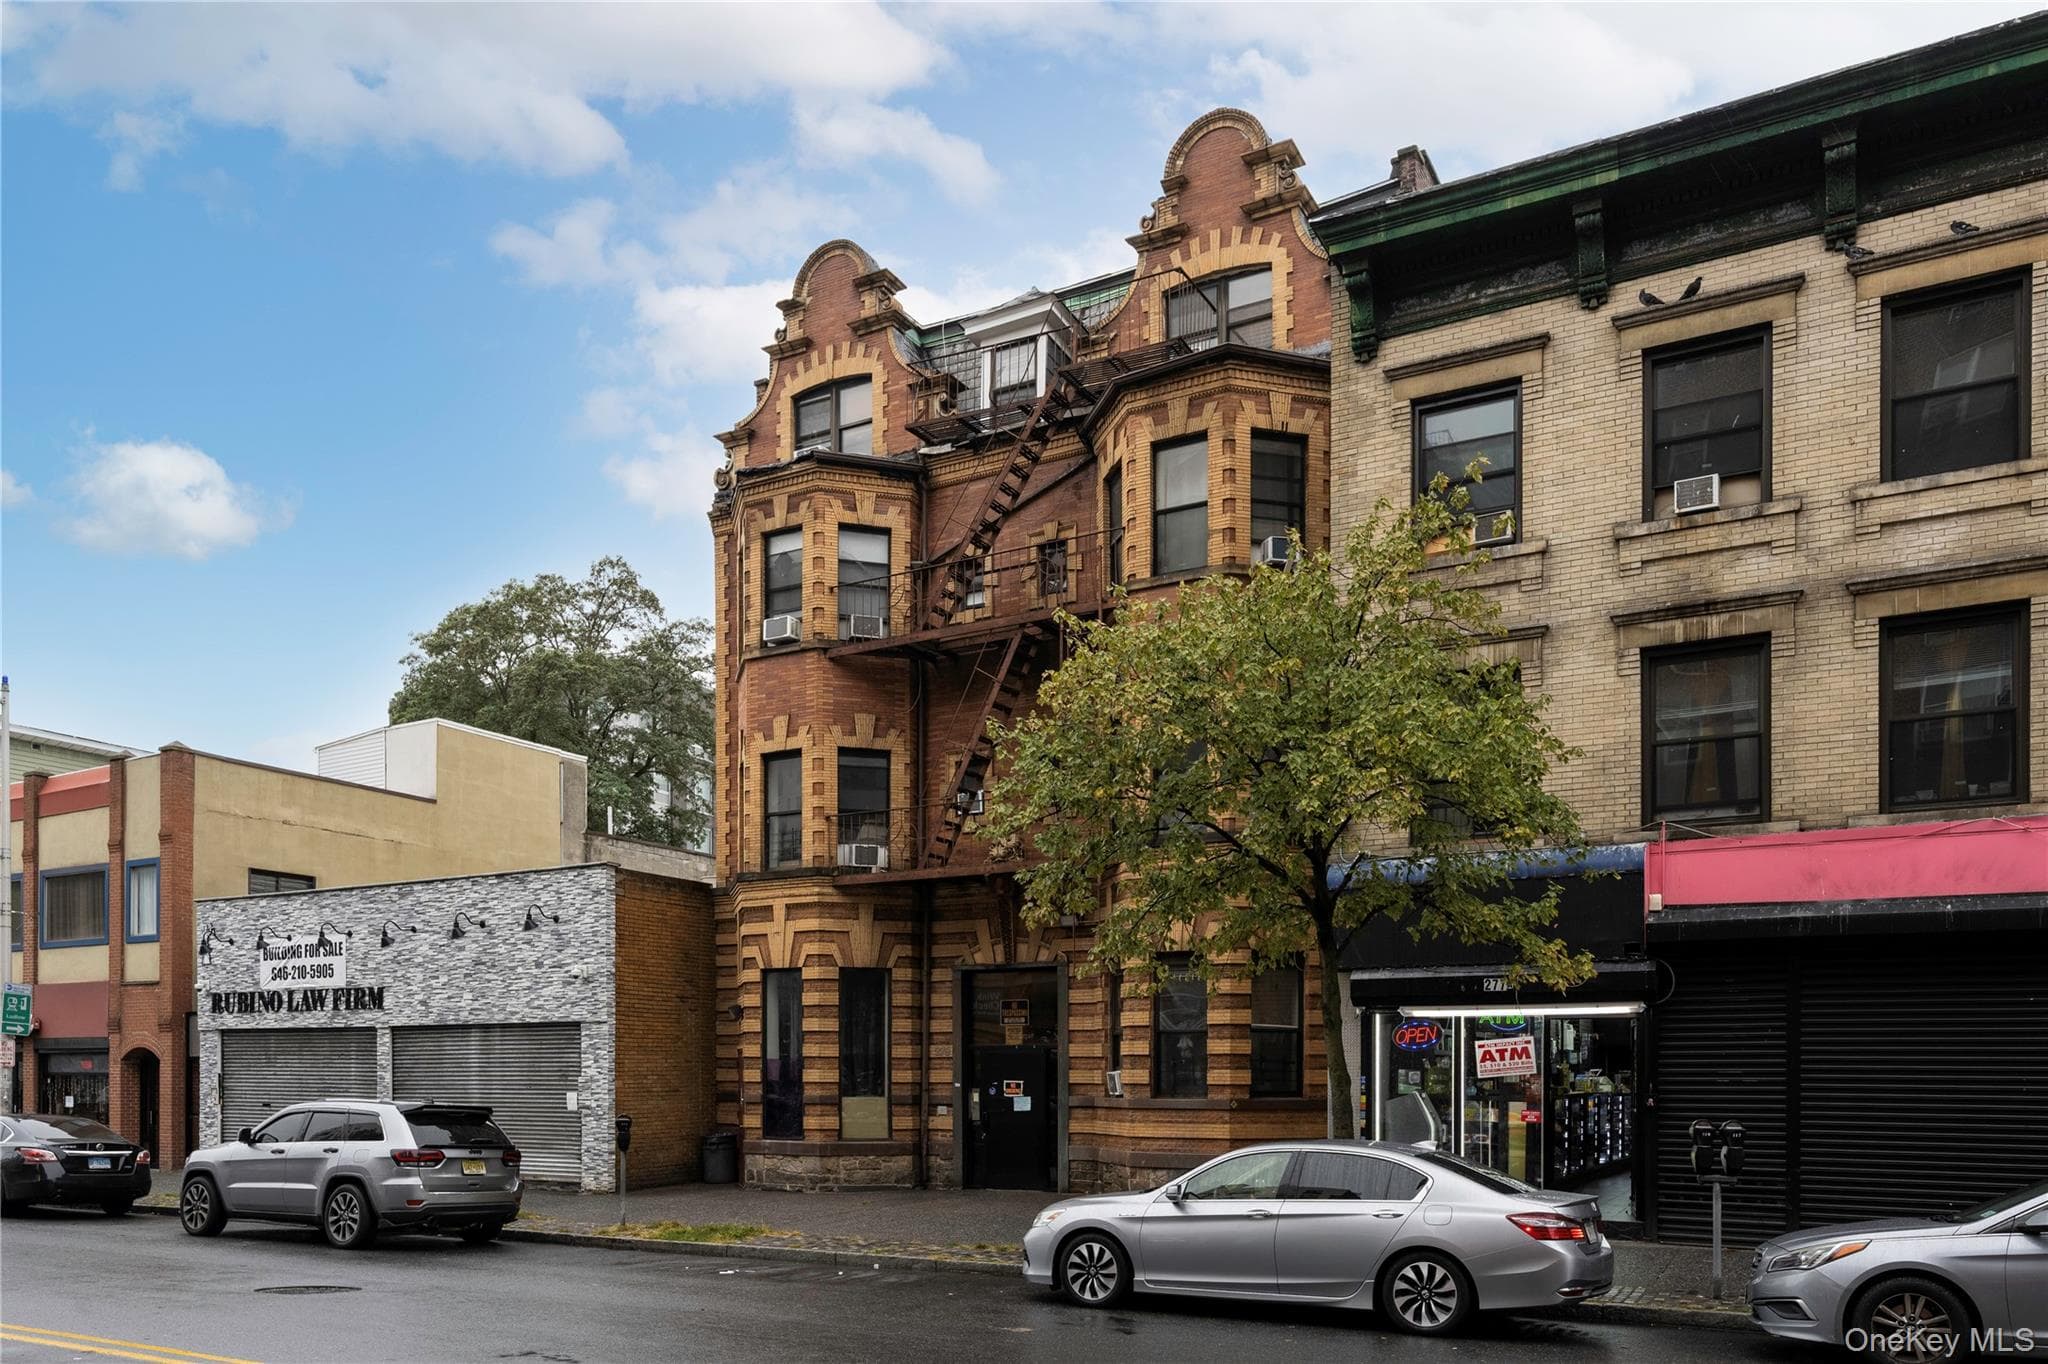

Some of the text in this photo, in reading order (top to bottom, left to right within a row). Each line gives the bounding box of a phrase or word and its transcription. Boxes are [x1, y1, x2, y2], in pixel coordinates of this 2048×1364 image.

[263, 944, 302, 961] BUILDING
[322, 942, 343, 957] SALE
[211, 987, 385, 1014] RUBINO LAW FIRM
[1395, 1026, 1437, 1044] OPEN
[1479, 1046, 1531, 1063] ATM
